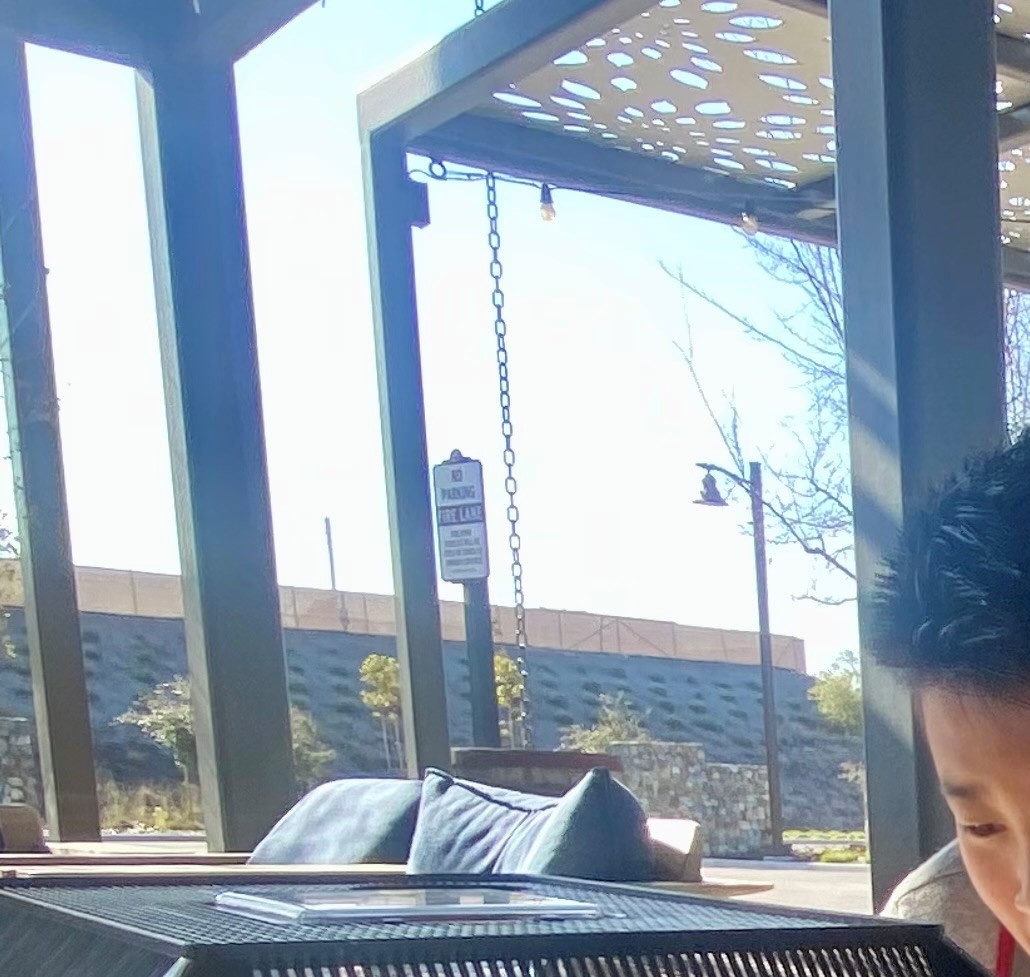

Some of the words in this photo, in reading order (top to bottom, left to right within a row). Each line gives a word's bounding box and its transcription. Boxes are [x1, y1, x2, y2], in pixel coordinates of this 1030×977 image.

[451, 469, 462, 482] NO
[440, 485, 475, 500] PARKING
[459, 506, 482, 522] LANE
